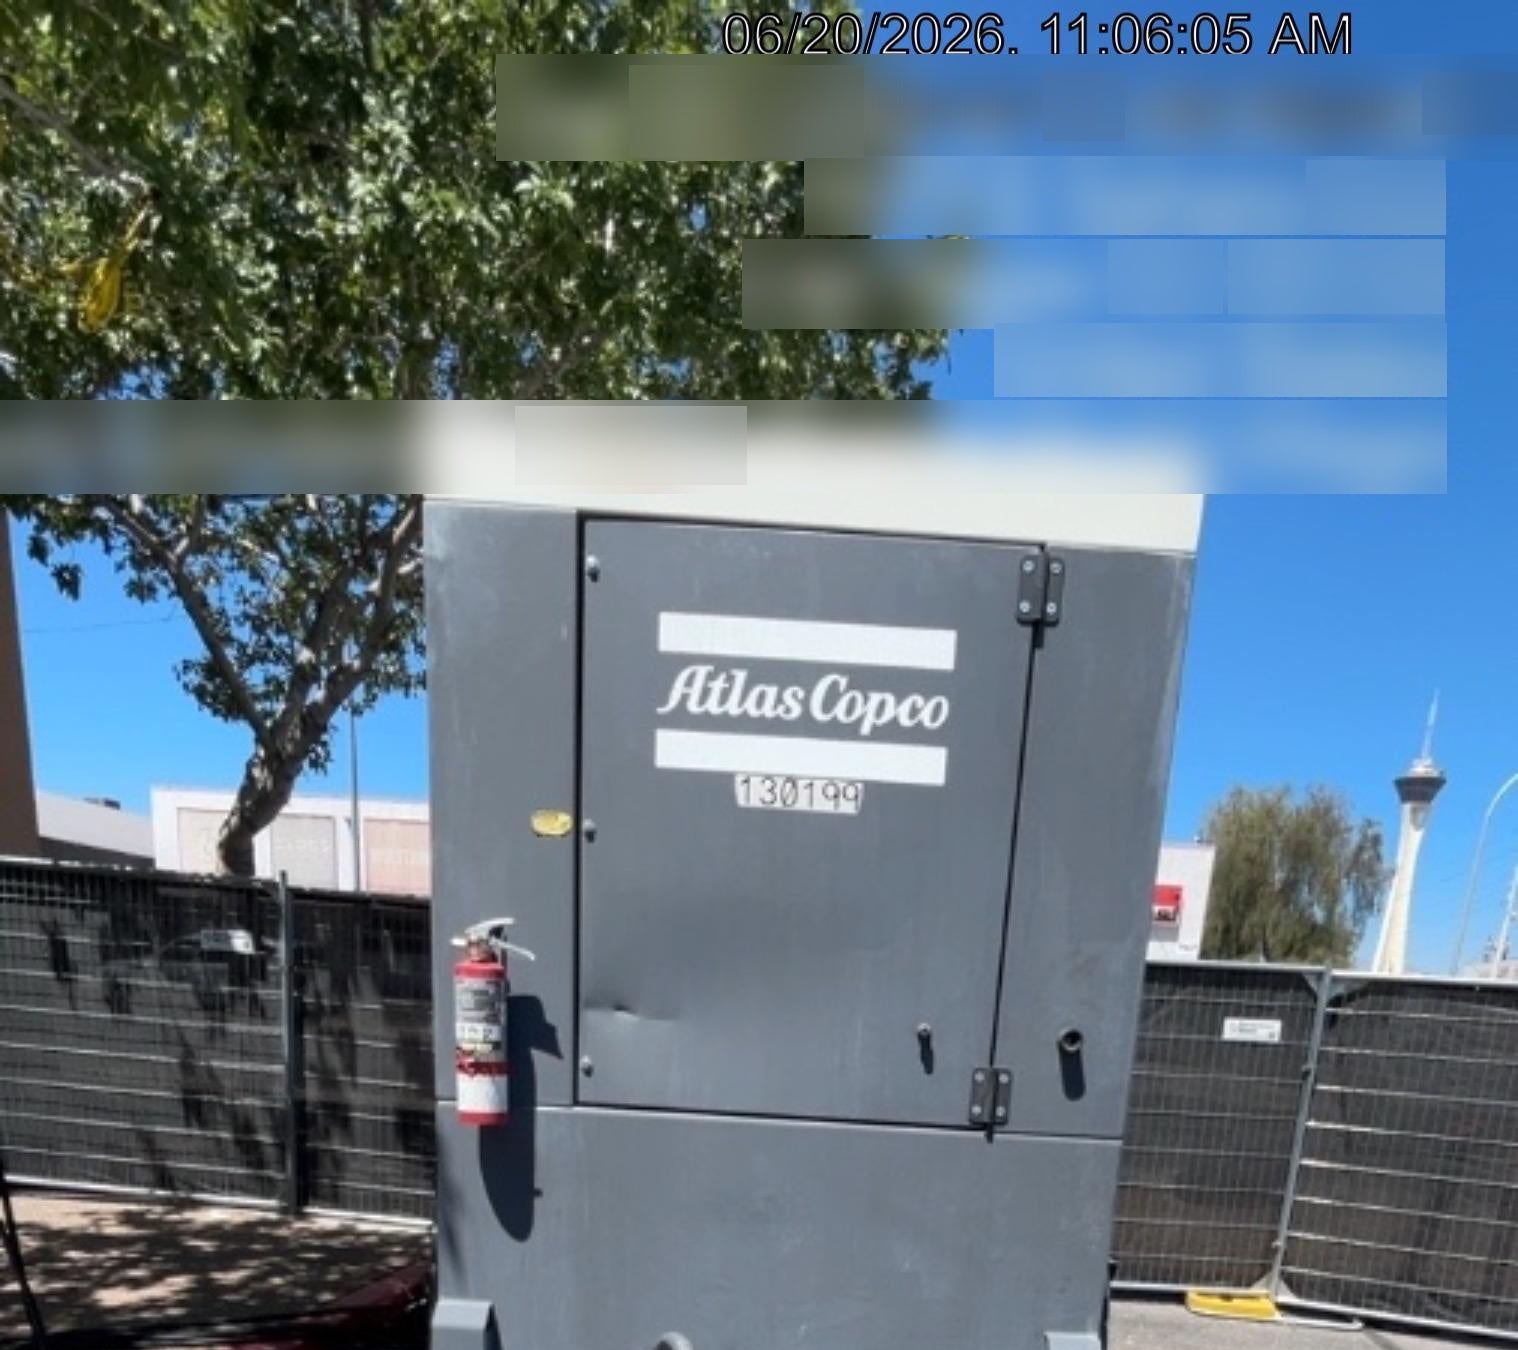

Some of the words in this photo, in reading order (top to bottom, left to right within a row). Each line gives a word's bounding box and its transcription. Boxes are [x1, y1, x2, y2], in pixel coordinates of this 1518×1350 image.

[656, 664, 803, 720] Atlas
[810, 673, 949, 736] Copco
[740, 774, 860, 811] 130199
